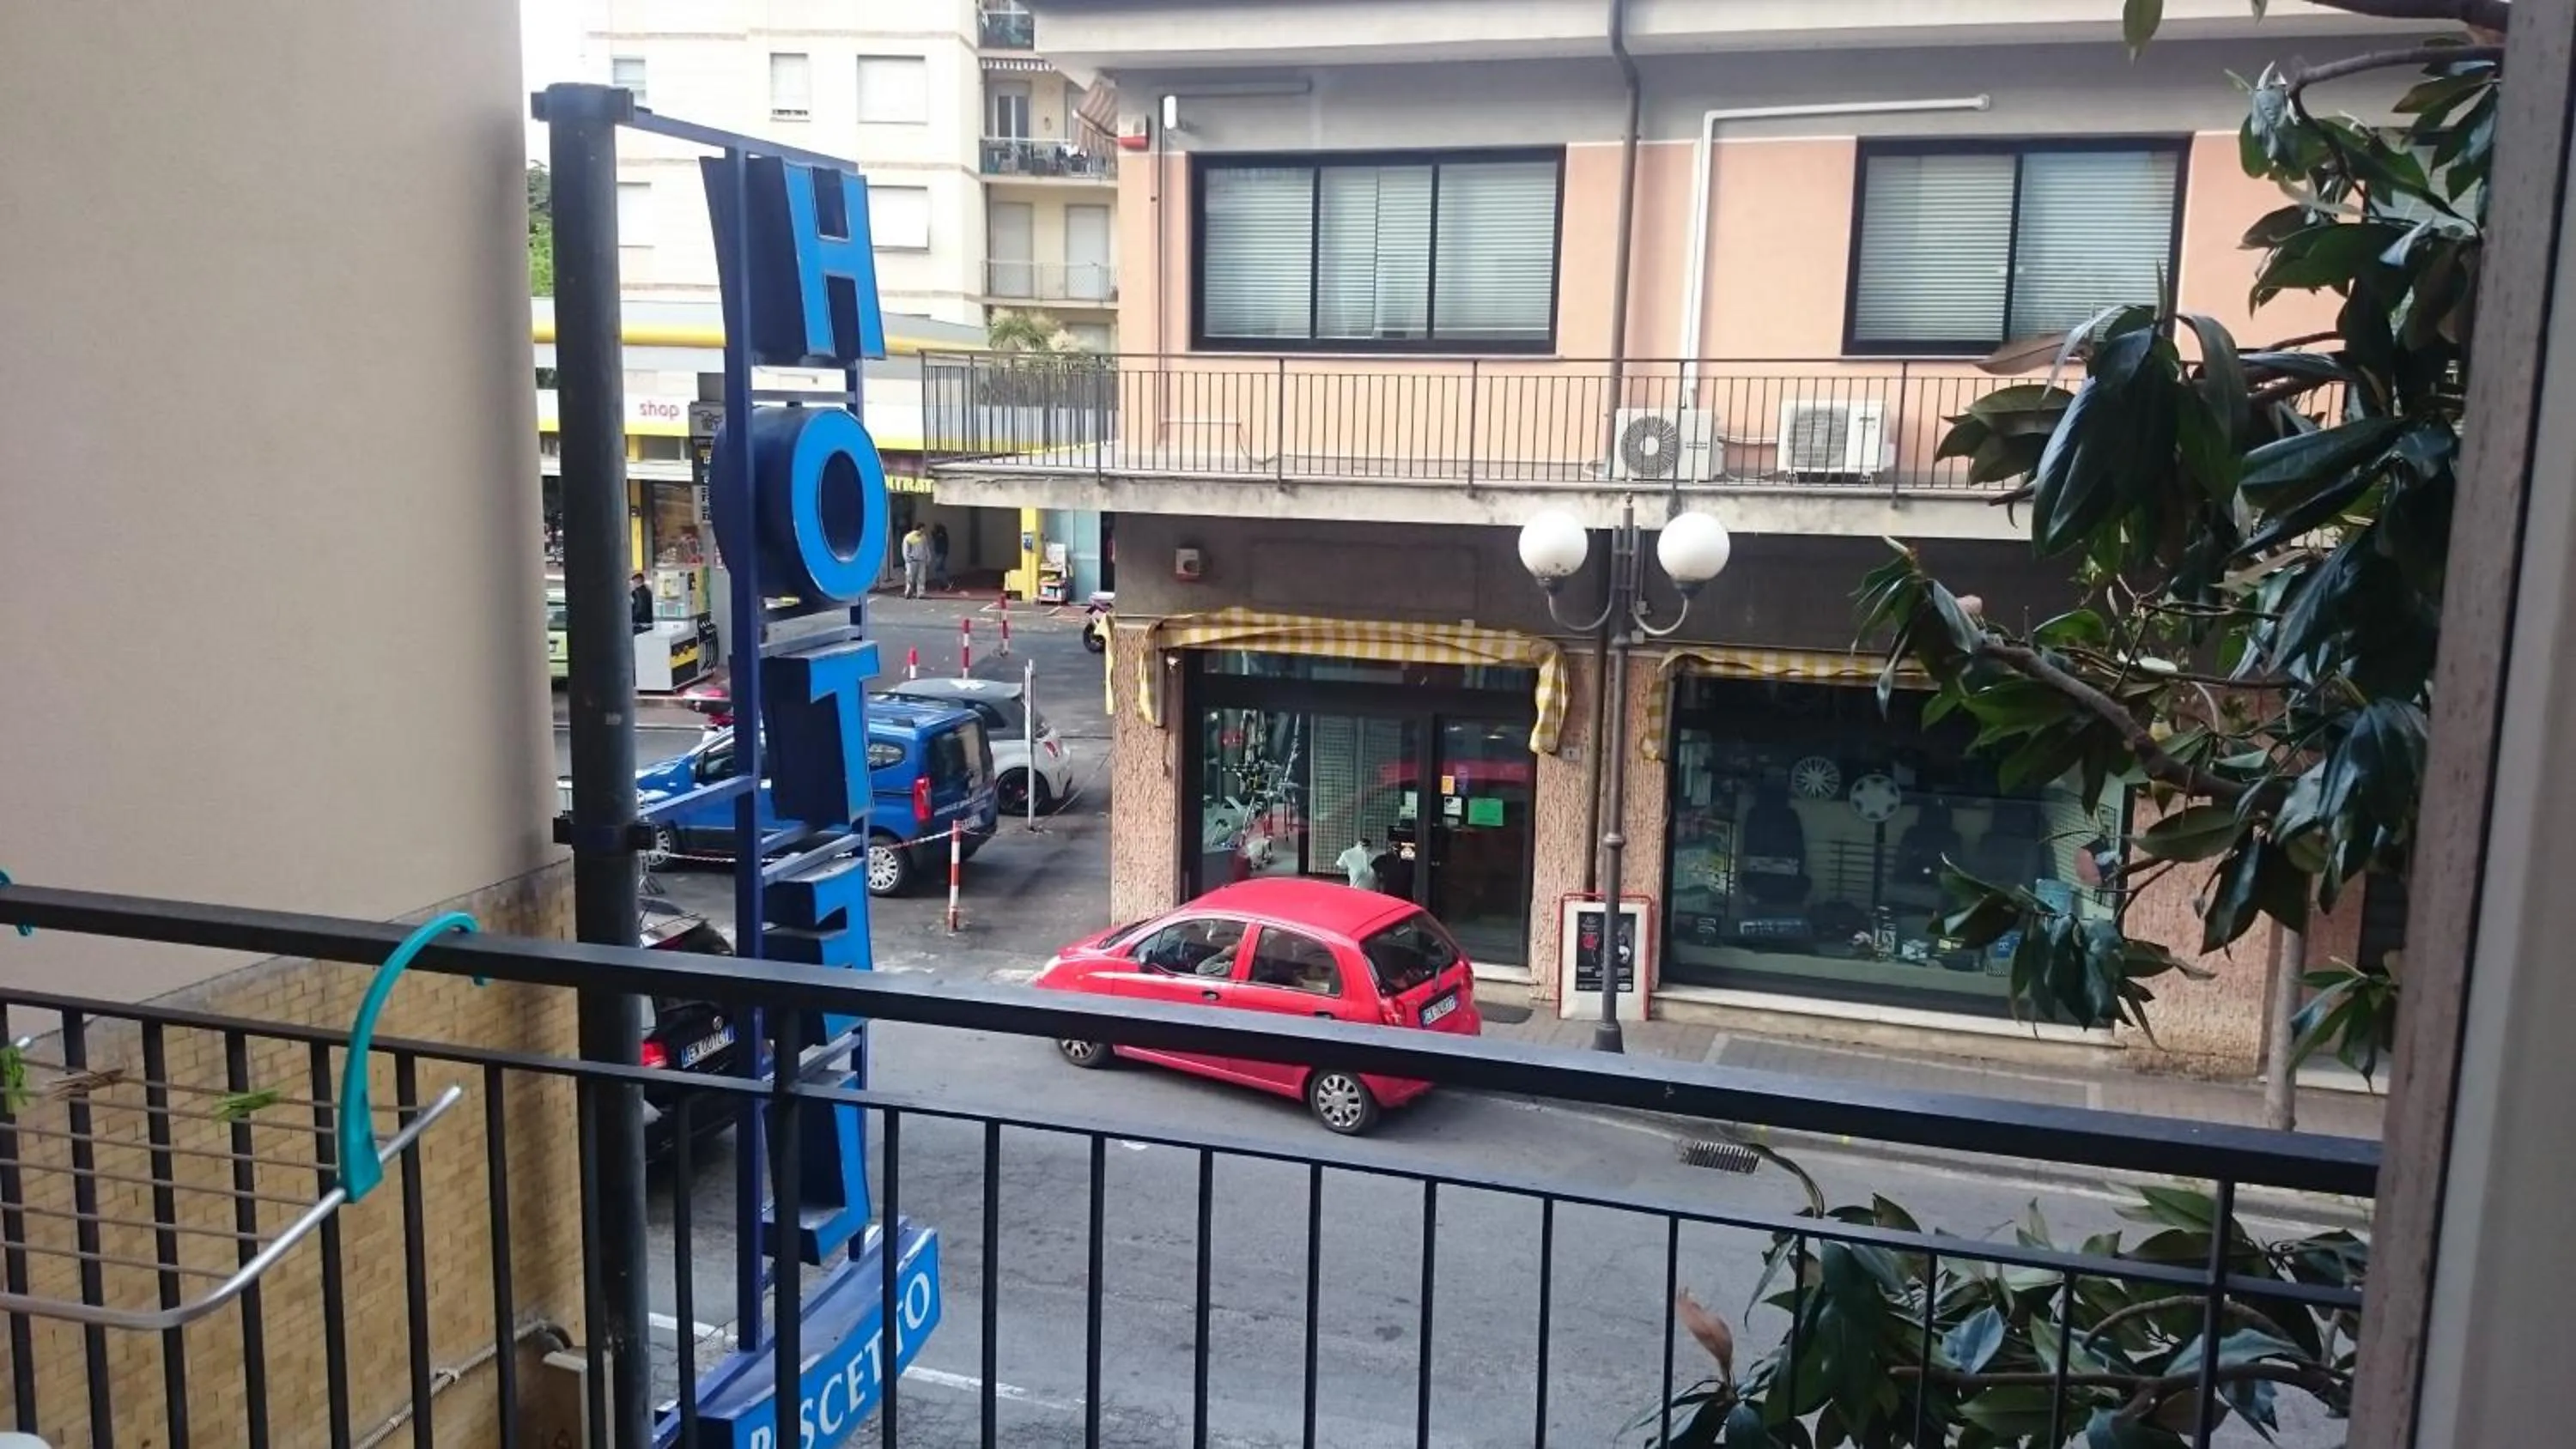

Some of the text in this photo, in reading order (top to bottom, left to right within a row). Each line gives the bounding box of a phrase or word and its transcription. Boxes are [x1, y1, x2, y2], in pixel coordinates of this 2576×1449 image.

[639, 400, 681, 421] shop
[884, 474, 935, 494] NTRAT
[750, 1271, 931, 1449] PSCETTO
